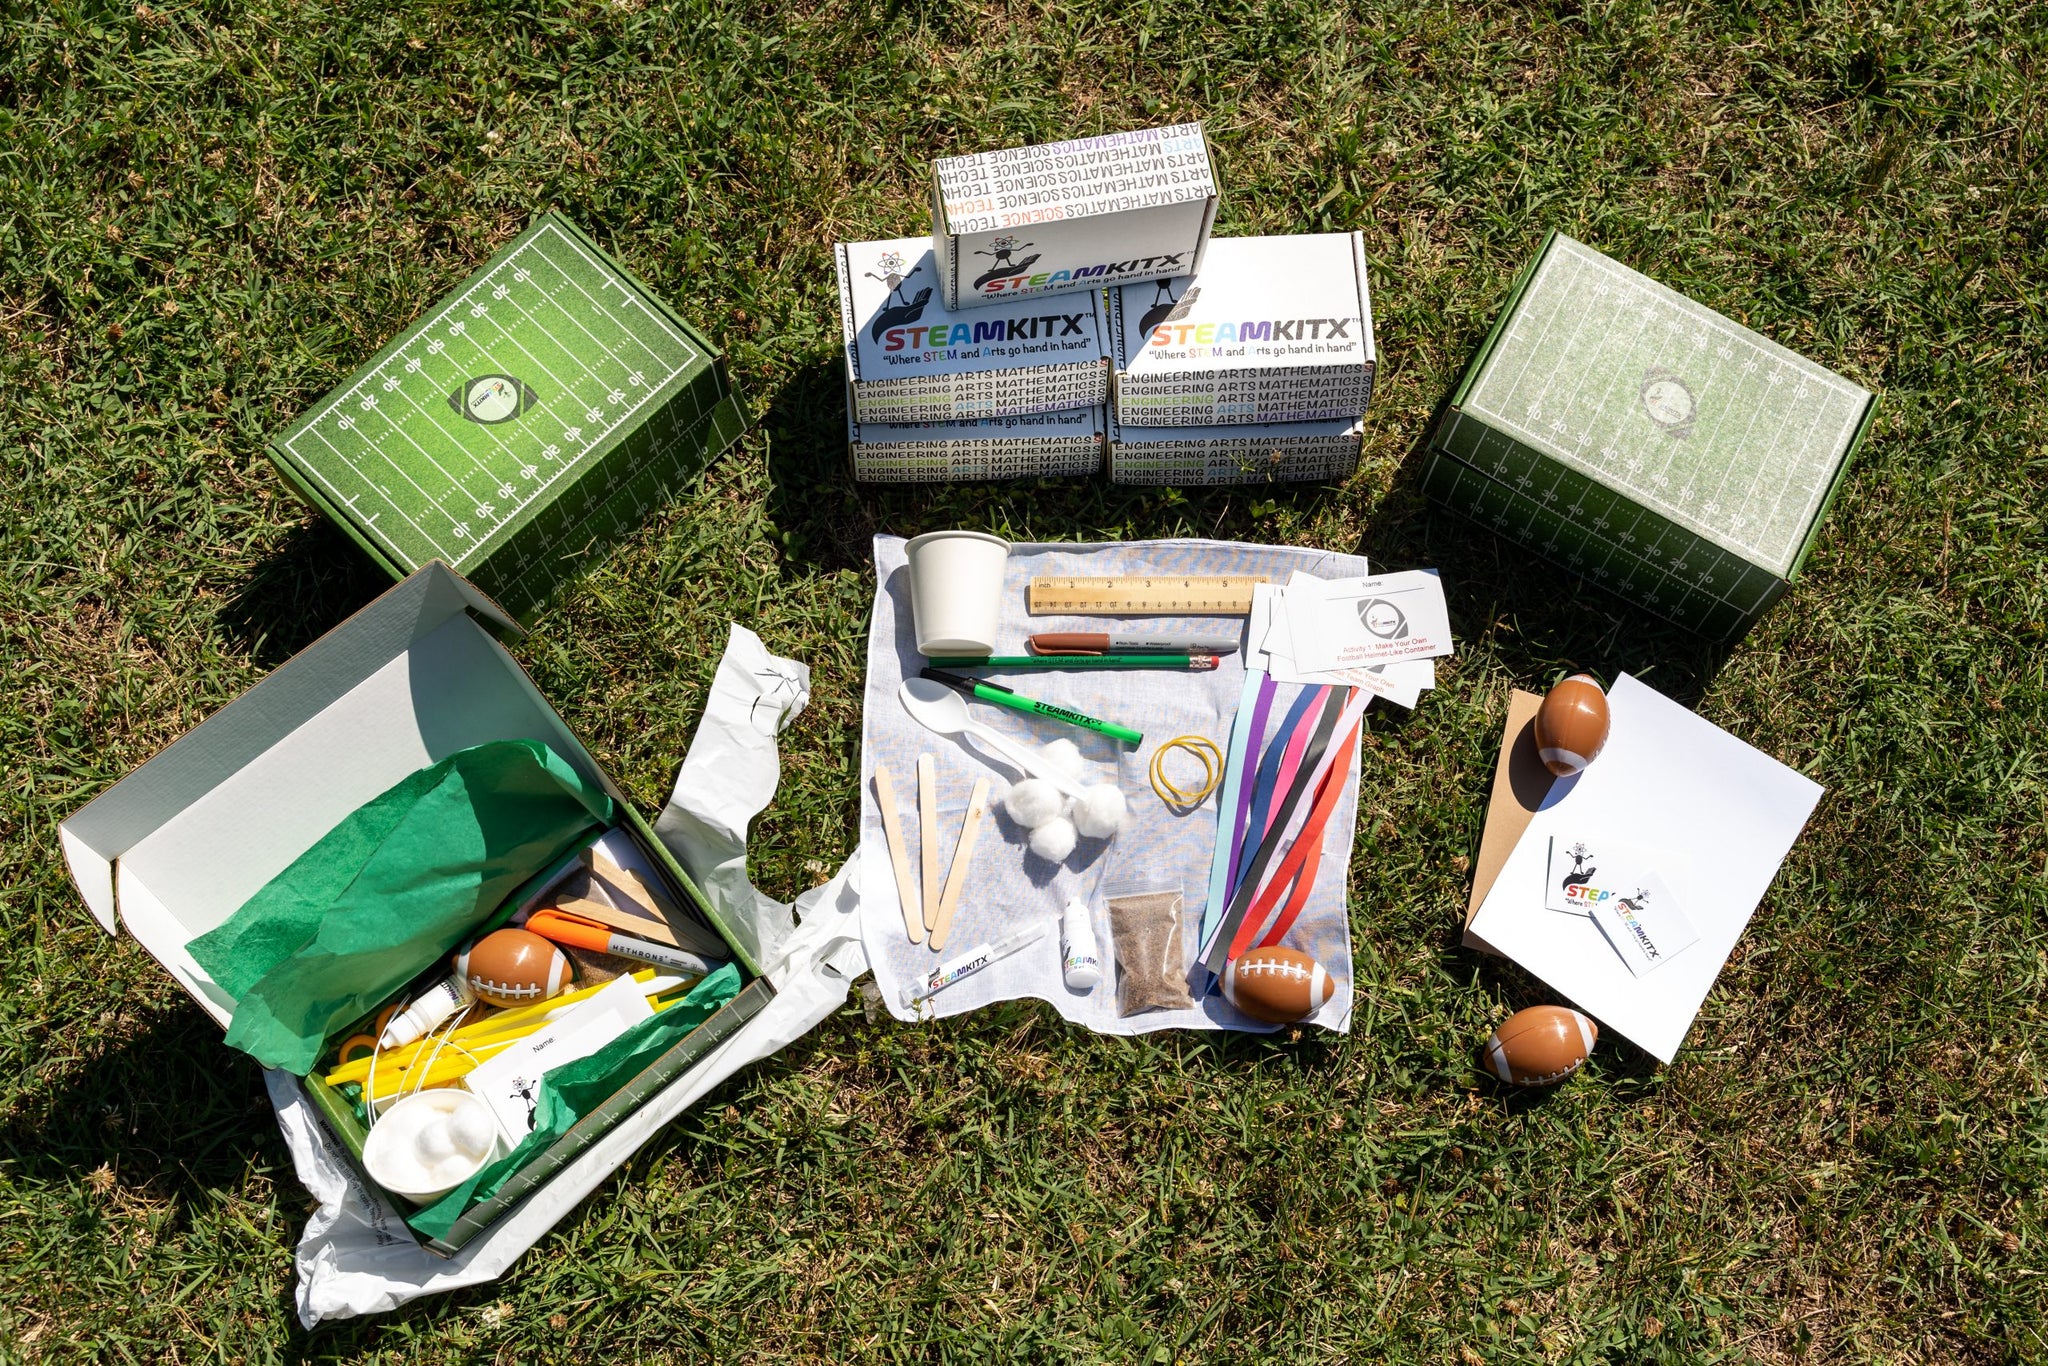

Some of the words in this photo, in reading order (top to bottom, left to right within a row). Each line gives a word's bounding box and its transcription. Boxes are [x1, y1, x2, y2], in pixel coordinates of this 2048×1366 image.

[514, 267, 531, 282] 10
[1021, 285, 1054, 295] STEM
[1057, 281, 1076, 290] and
[1118, 271, 1143, 280] hand
[492, 283, 510, 300] 20
[471, 302, 489, 318] 30
[449, 321, 465, 336] 40
[427, 339, 445, 355] 50
[923, 349, 958, 362] STEM
[961, 347, 980, 359] and
[983, 346, 1006, 357] Arts
[1008, 346, 1021, 358] go
[1023, 341, 1048, 354] hand
[1050, 342, 1060, 351] in
[1226, 346, 1245, 357] and
[1248, 345, 1271, 355] Arts
[1273, 346, 1286, 357] go
[1288, 343, 1313, 355] hand
[1315, 344, 1325, 352] in
[405, 358, 422, 373] 40
[1121, 370, 1215, 383] ENGINEERING
[1218, 368, 1257, 379] ARTS
[1259, 364, 1361, 377] MATHEMATICS
[629, 370, 645, 387] 10
[856, 373, 950, 389] ENGINEERING
[954, 370, 992, 381] ARTS
[995, 360, 1097, 377] MATHEMATICS
[383, 376, 401, 392] 30
[857, 385, 951, 399] ENGINEERING
[954, 381, 992, 392] ARTS
[1121, 383, 1214, 395] ENGINEERING
[1217, 381, 1256, 391] ARTS
[360, 394, 379, 411] 20
[607, 388, 626, 405] 20
[858, 394, 951, 408] ENGINEERING
[955, 391, 992, 401] ARTS
[1121, 394, 1213, 406] ENGINEERING
[1217, 393, 1255, 402] ARTS
[585, 407, 604, 424] 30
[859, 403, 950, 415] ENGINEERING
[955, 400, 992, 410] ARTS
[860, 411, 951, 422] ENGINEERING
[955, 409, 992, 418] ARTS
[1121, 405, 1213, 416] ENGINEERING
[1217, 404, 1255, 413] ARTS
[338, 415, 355, 430] 10
[1005, 418, 1017, 428] go
[1020, 415, 1044, 426] hand
[1047, 415, 1056, 424] in
[1122, 415, 1212, 424] ENGINEERING
[1216, 413, 1254, 423] ARTS
[564, 427, 582, 442] 40
[856, 440, 947, 450] ENGINEERING
[950, 439, 988, 447] ARTS
[991, 436, 1091, 446] MATHEMATICS
[542, 444, 560, 460] 50
[857, 450, 947, 459] ENGINEERING
[951, 449, 988, 457] ARTS
[520, 464, 538, 480] 40
[498, 482, 516, 499] 30
[475, 501, 496, 519] 20
[453, 521, 470, 538] 10
[532, 1034, 556, 1055] Name:
